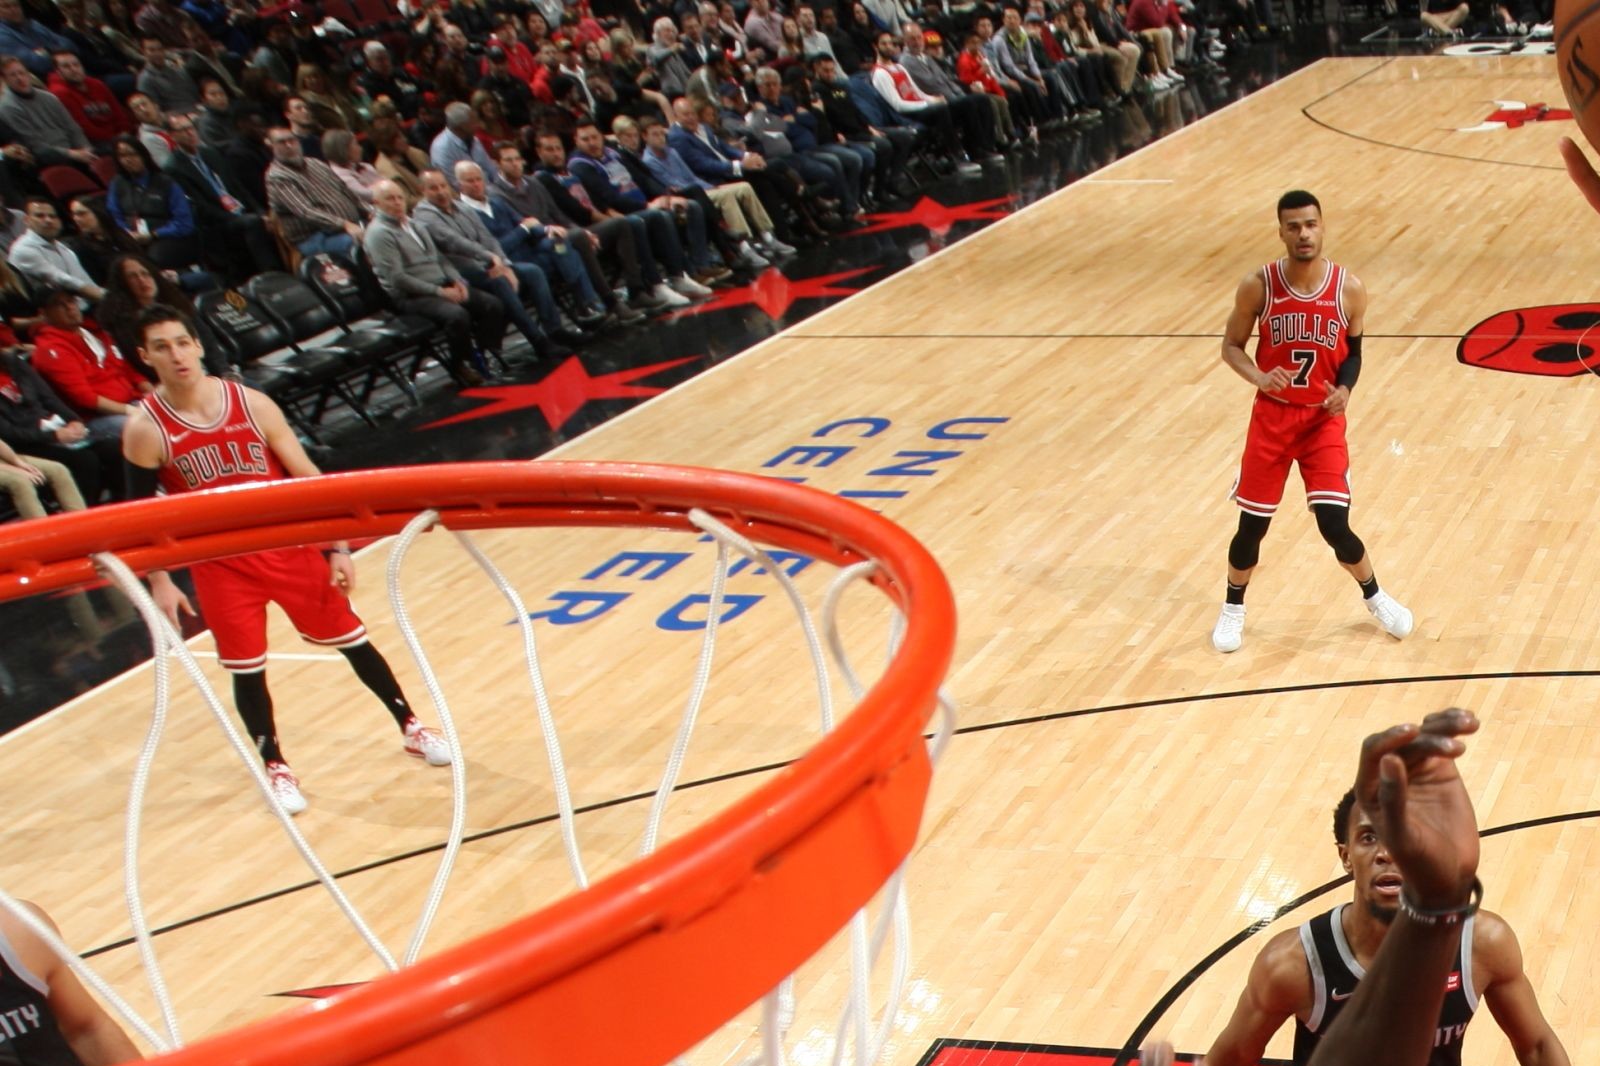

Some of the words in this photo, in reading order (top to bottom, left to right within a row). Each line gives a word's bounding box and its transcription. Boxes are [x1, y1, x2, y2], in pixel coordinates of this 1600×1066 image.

[1268, 312, 1341, 351] BULLS
[1291, 349, 1317, 388] 7
[171, 440, 272, 490] BULLS
[504, 416, 892, 626] CEER
[655, 416, 1011, 631] UNIED
[0, 1003, 41, 1043] ITY
